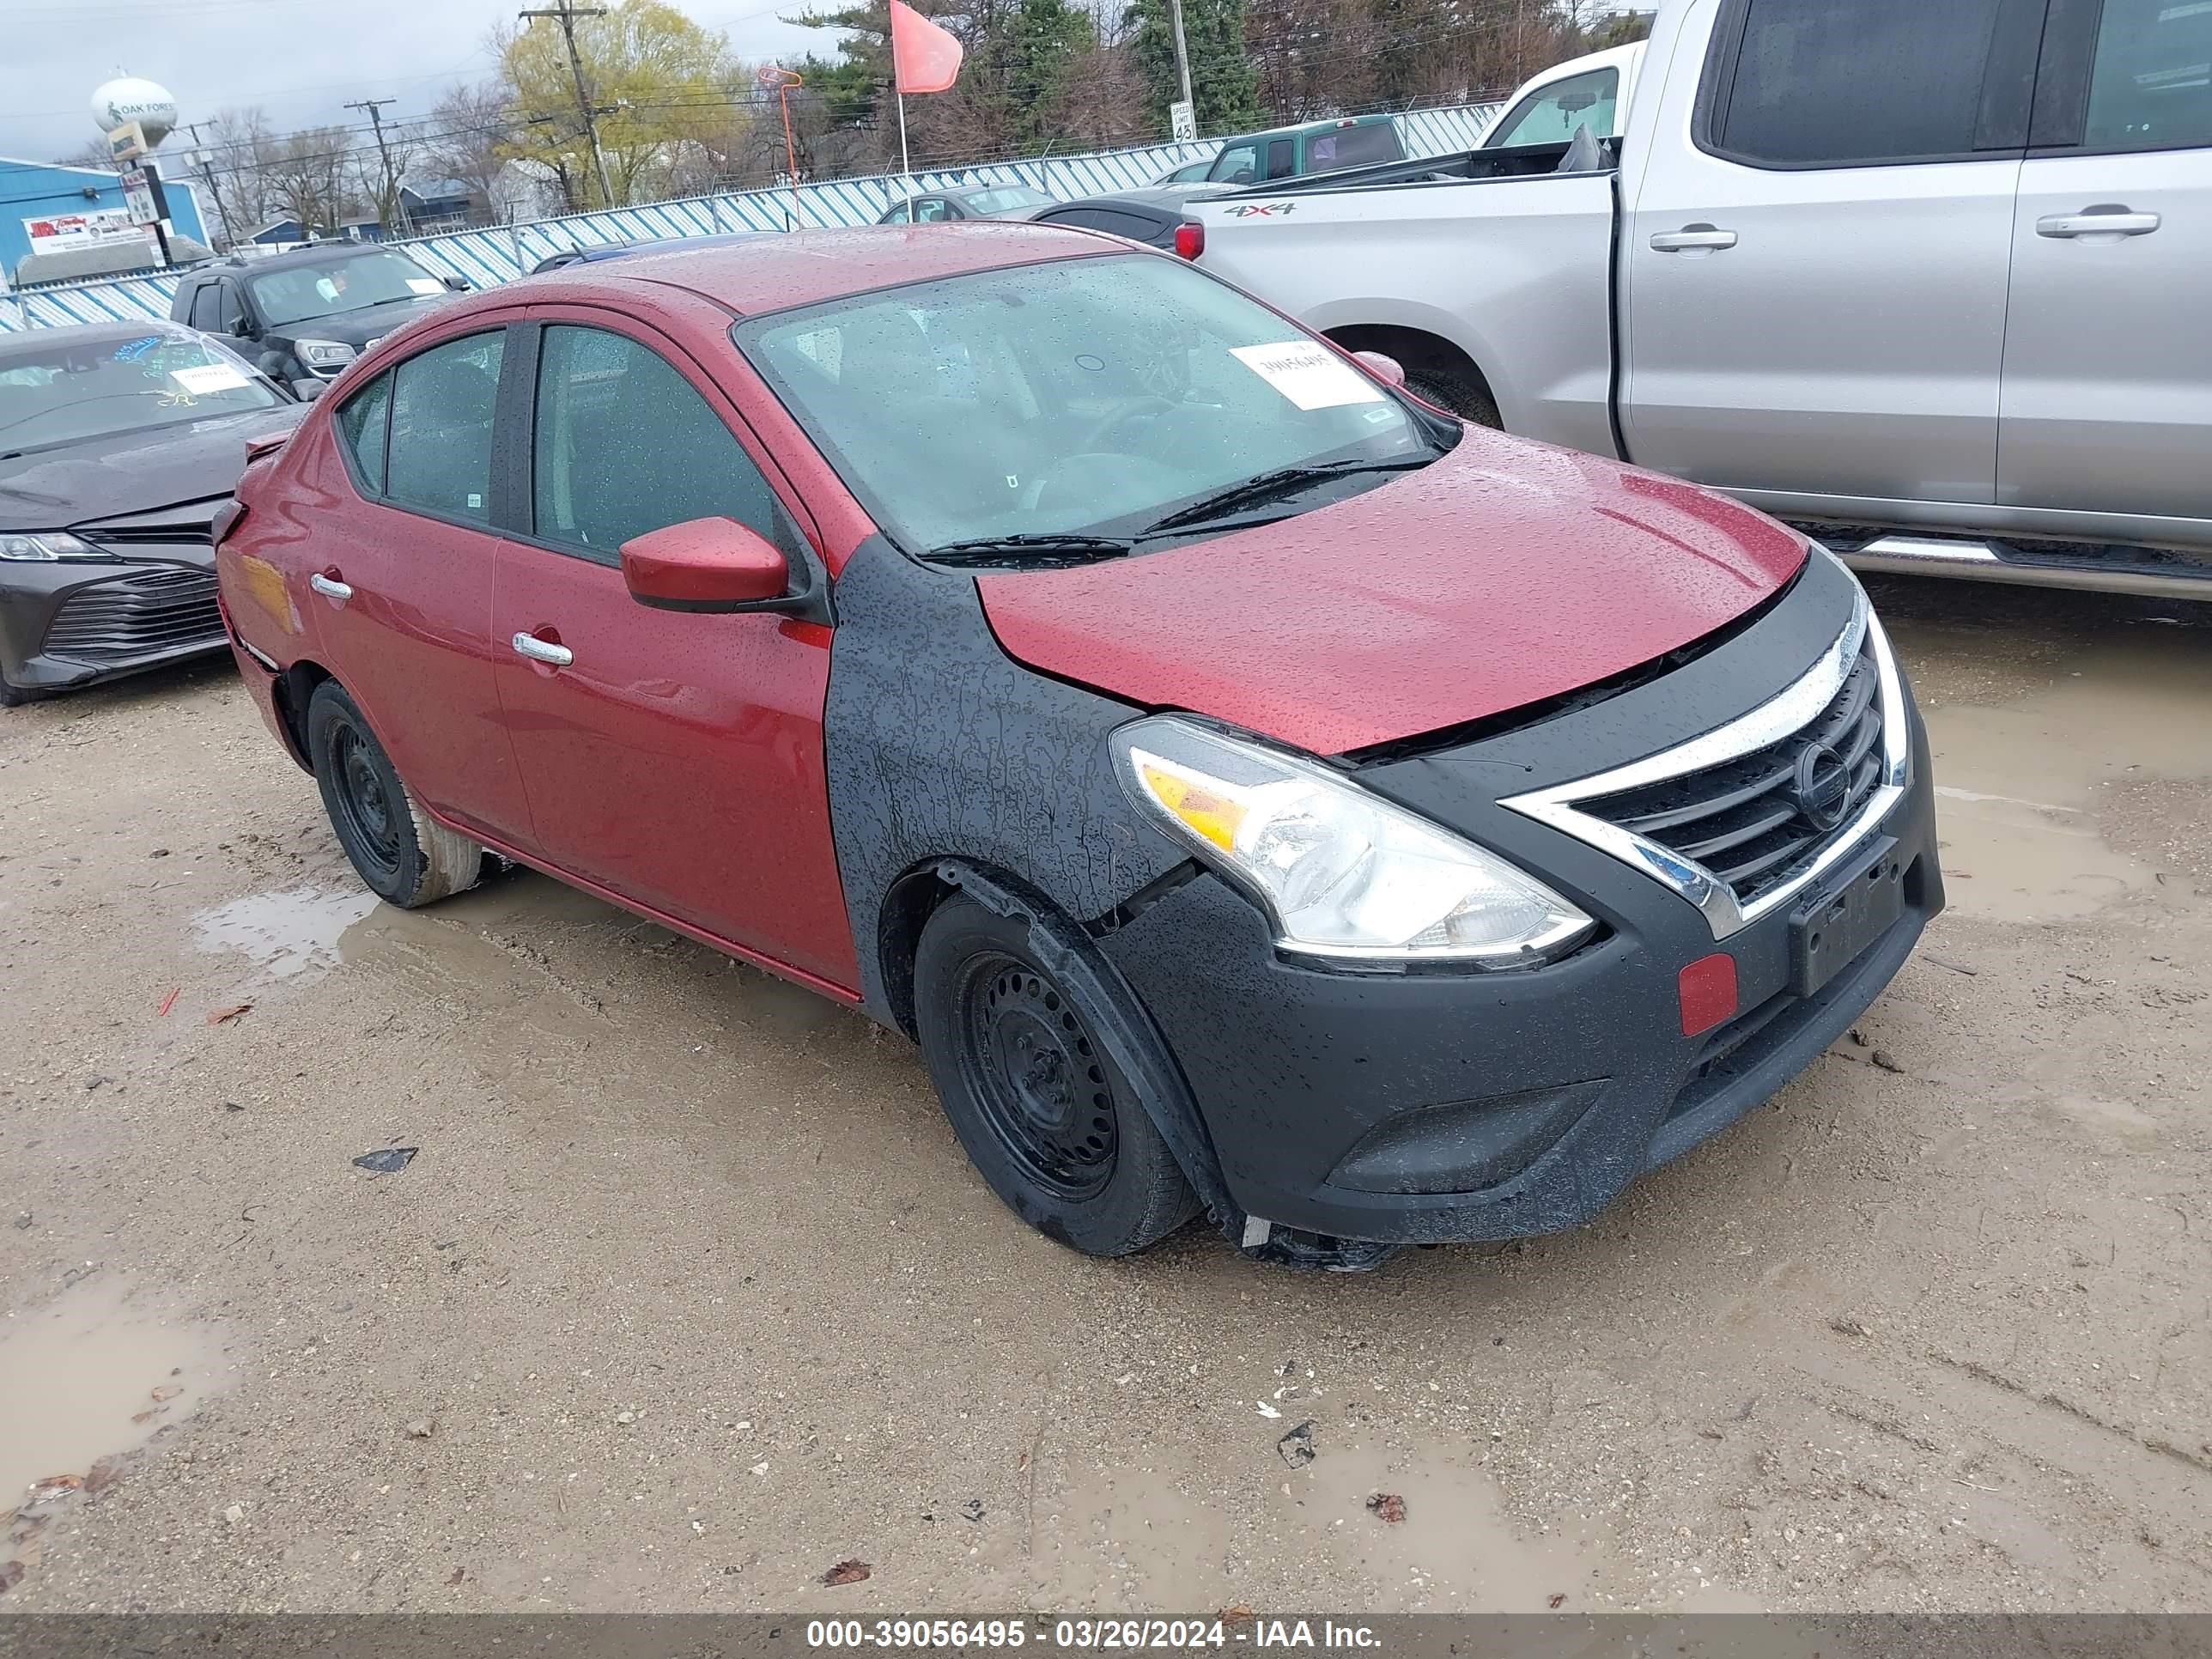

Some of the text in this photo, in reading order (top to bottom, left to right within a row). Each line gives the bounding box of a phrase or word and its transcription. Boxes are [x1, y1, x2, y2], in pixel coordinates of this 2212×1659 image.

[121, 102, 174, 114] OAK FORES
[1173, 106, 1189, 115] SPEED
[1175, 115, 1188, 124] LIMIT
[1176, 125, 1192, 139] 45
